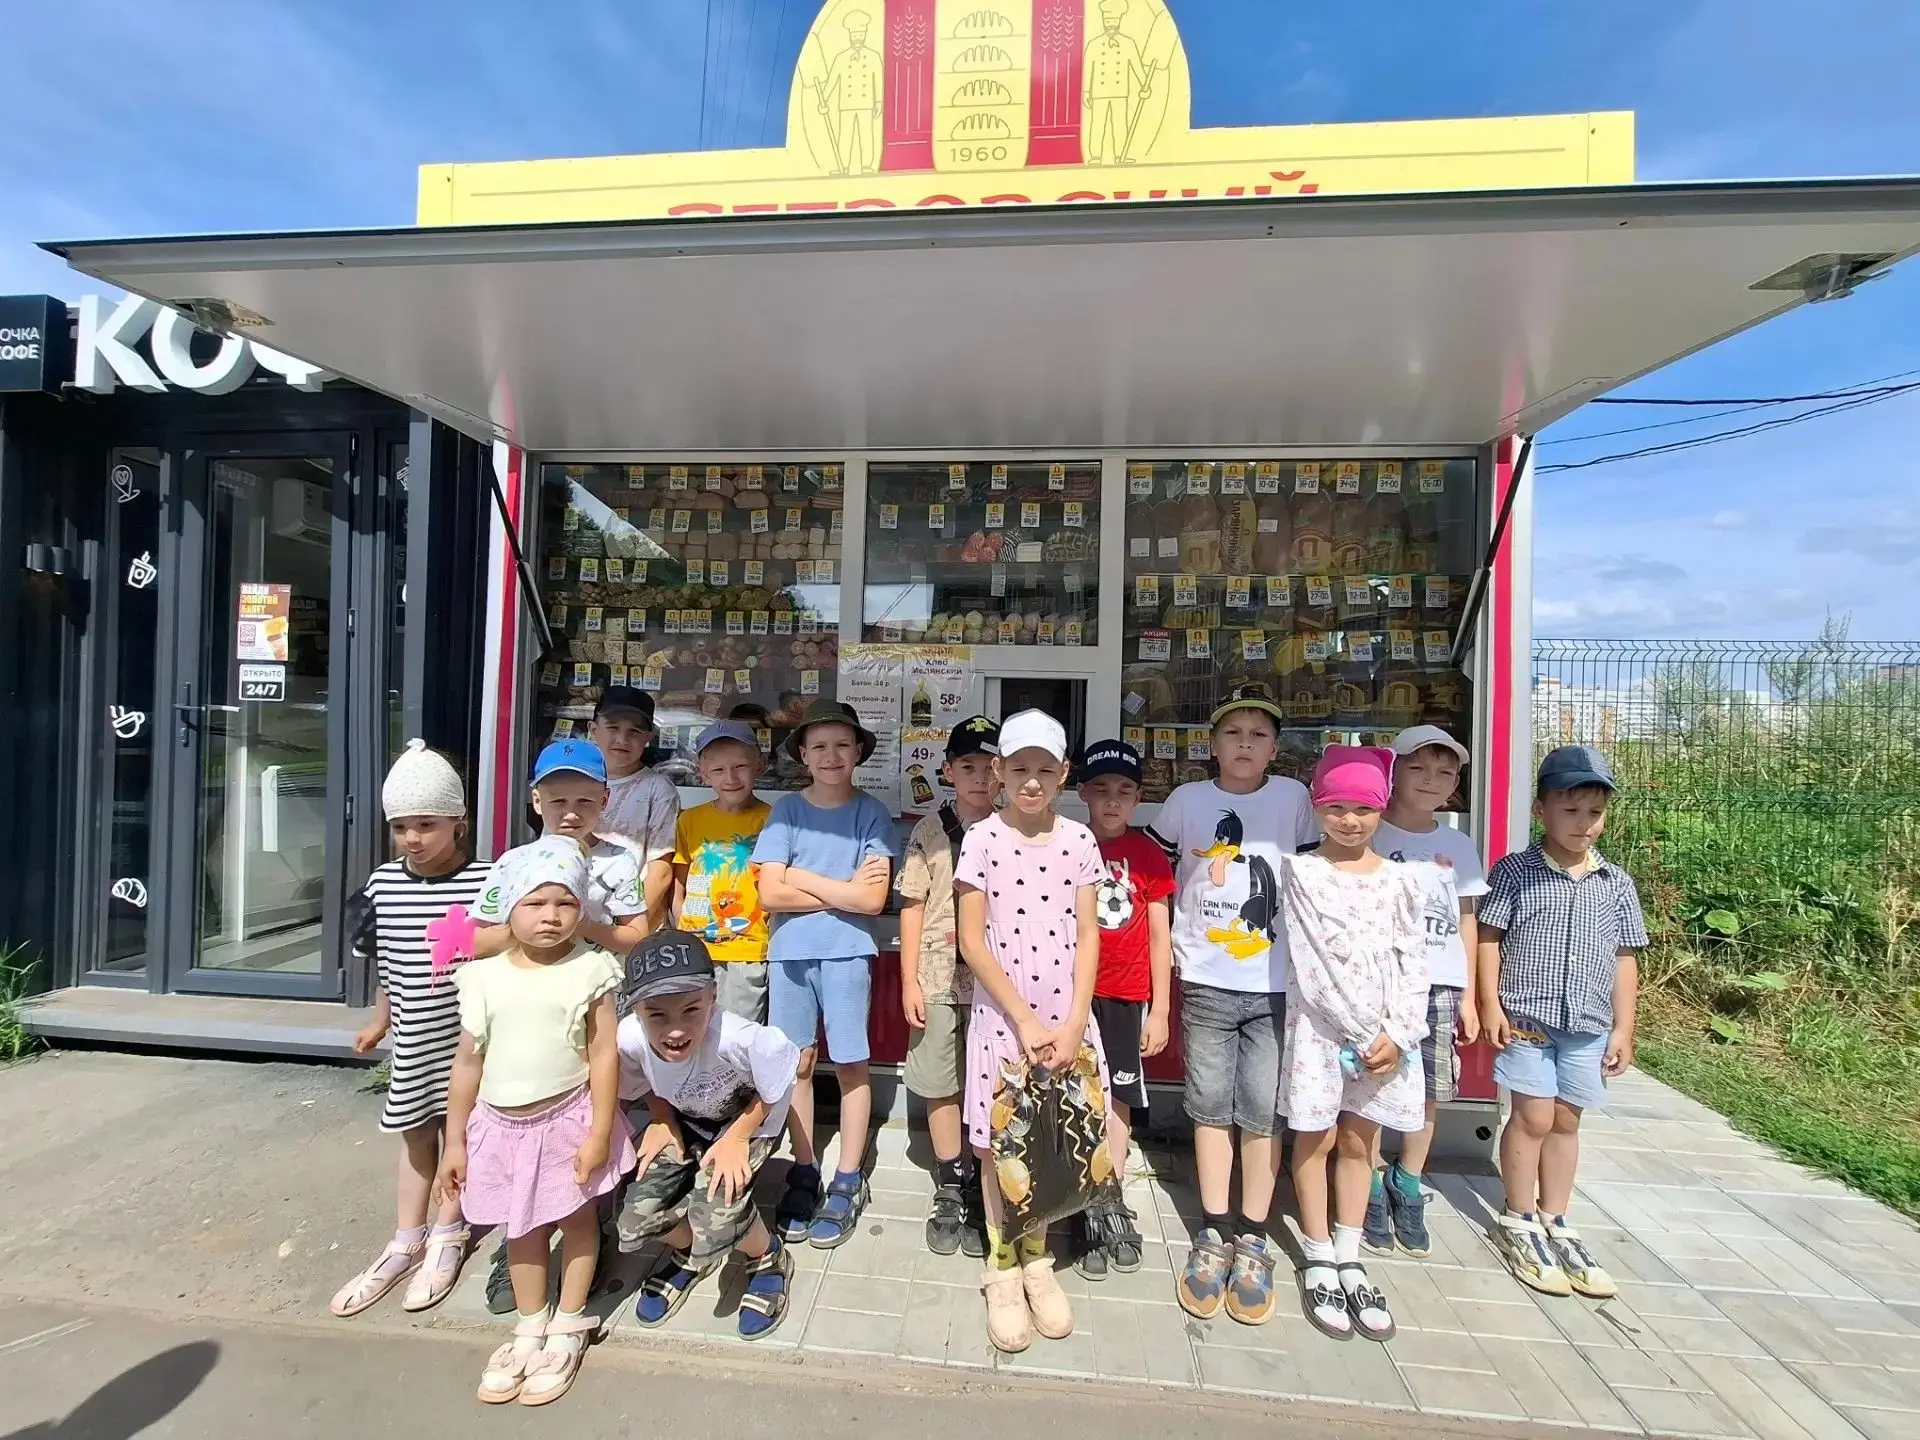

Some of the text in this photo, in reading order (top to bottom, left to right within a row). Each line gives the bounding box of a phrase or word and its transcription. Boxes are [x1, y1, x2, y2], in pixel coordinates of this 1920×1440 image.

[950, 146, 1007, 163] 1960
[0, 344, 40, 361] ОФЕ
[925, 658, 949, 667] Хлеб
[247, 684, 277, 696] 24/7
[1087, 750, 1137, 766] DREAM BIG
[1203, 900, 1219, 909] CAN
[1221, 902, 1240, 911] AND
[1203, 909, 1224, 918] WILL
[631, 944, 692, 982] BEST
[716, 1068, 736, 1082] THAN
[1116, 1069, 1137, 1082] NIKE
